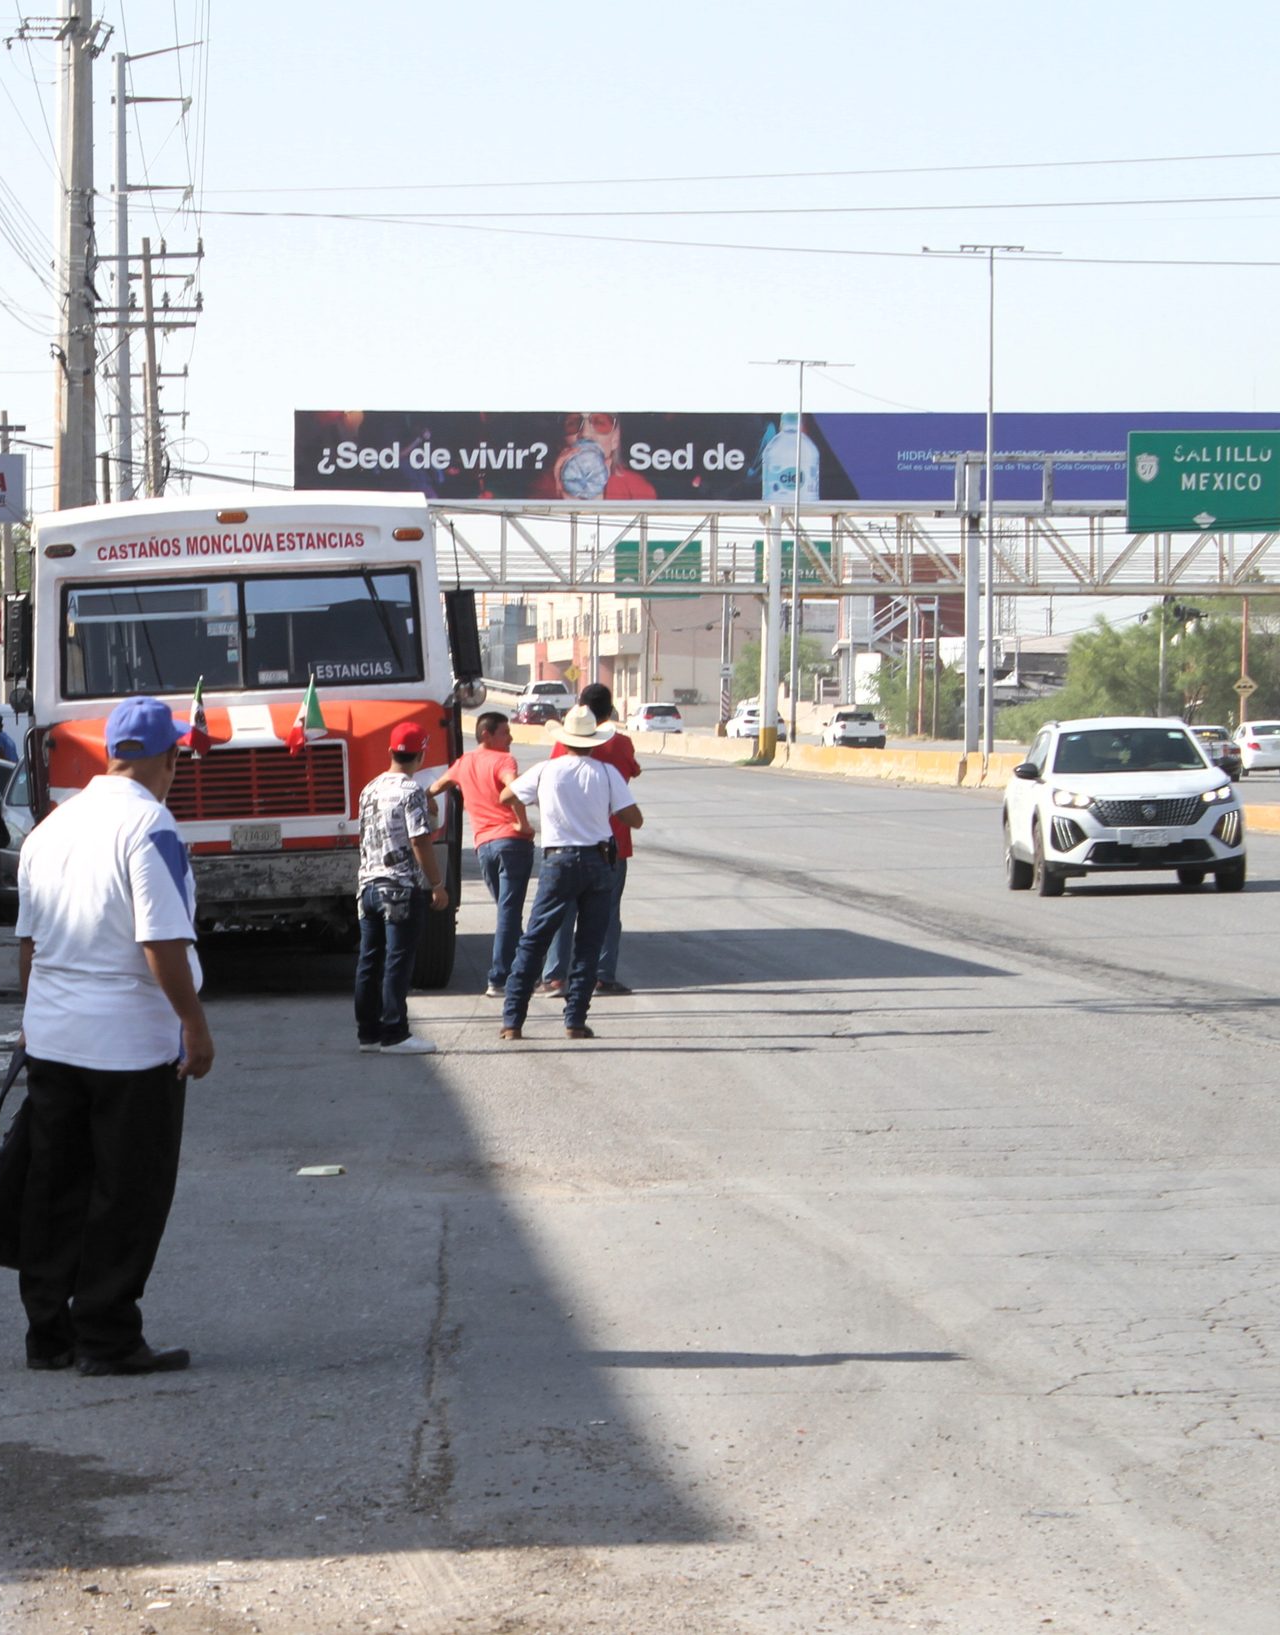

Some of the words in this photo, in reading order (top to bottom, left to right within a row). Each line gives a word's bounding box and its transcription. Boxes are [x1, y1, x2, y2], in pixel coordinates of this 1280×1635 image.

[317, 441, 391, 475] ¿Sed
[410, 442, 451, 470] de
[459, 442, 548, 470] vivir?
[629, 442, 694, 471] Sed
[703, 442, 745, 471] de
[1181, 472, 1262, 491] MEXICO
[97, 536, 181, 561] CASTAÑOS
[186, 532, 274, 556] MONCLOVA
[276, 531, 365, 551] ESTANCIAS
[316, 661, 393, 679] ESTANCIAS
